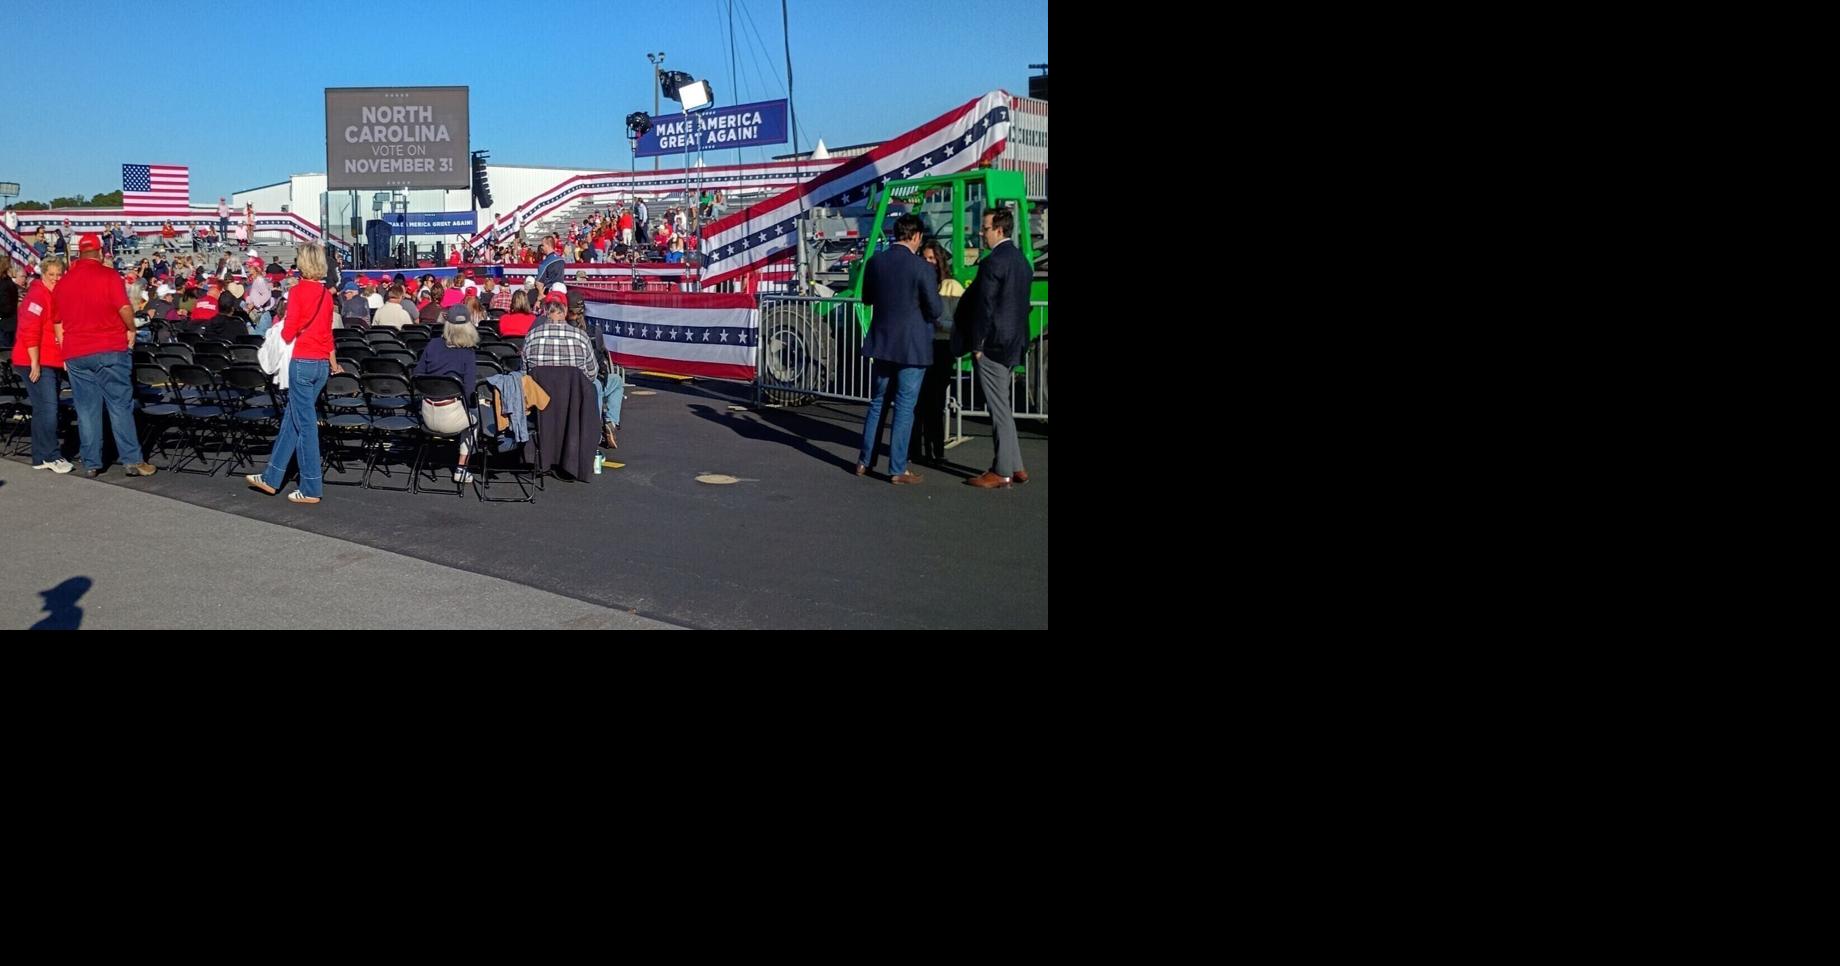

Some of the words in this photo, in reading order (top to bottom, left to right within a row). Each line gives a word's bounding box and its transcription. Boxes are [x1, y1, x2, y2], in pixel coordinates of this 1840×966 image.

[362, 106, 432, 123] NORTH
[656, 120, 693, 136] MAKE
[697, 111, 762, 131] AMERICA
[344, 125, 450, 143] CAROLINA
[660, 132, 702, 149] GREAT
[707, 126, 758, 144] AGAIN!
[371, 145, 403, 157] VOTE
[407, 144, 426, 156] ON
[344, 158, 434, 173] NOVEMBER
[439, 157, 453, 172] 3!
